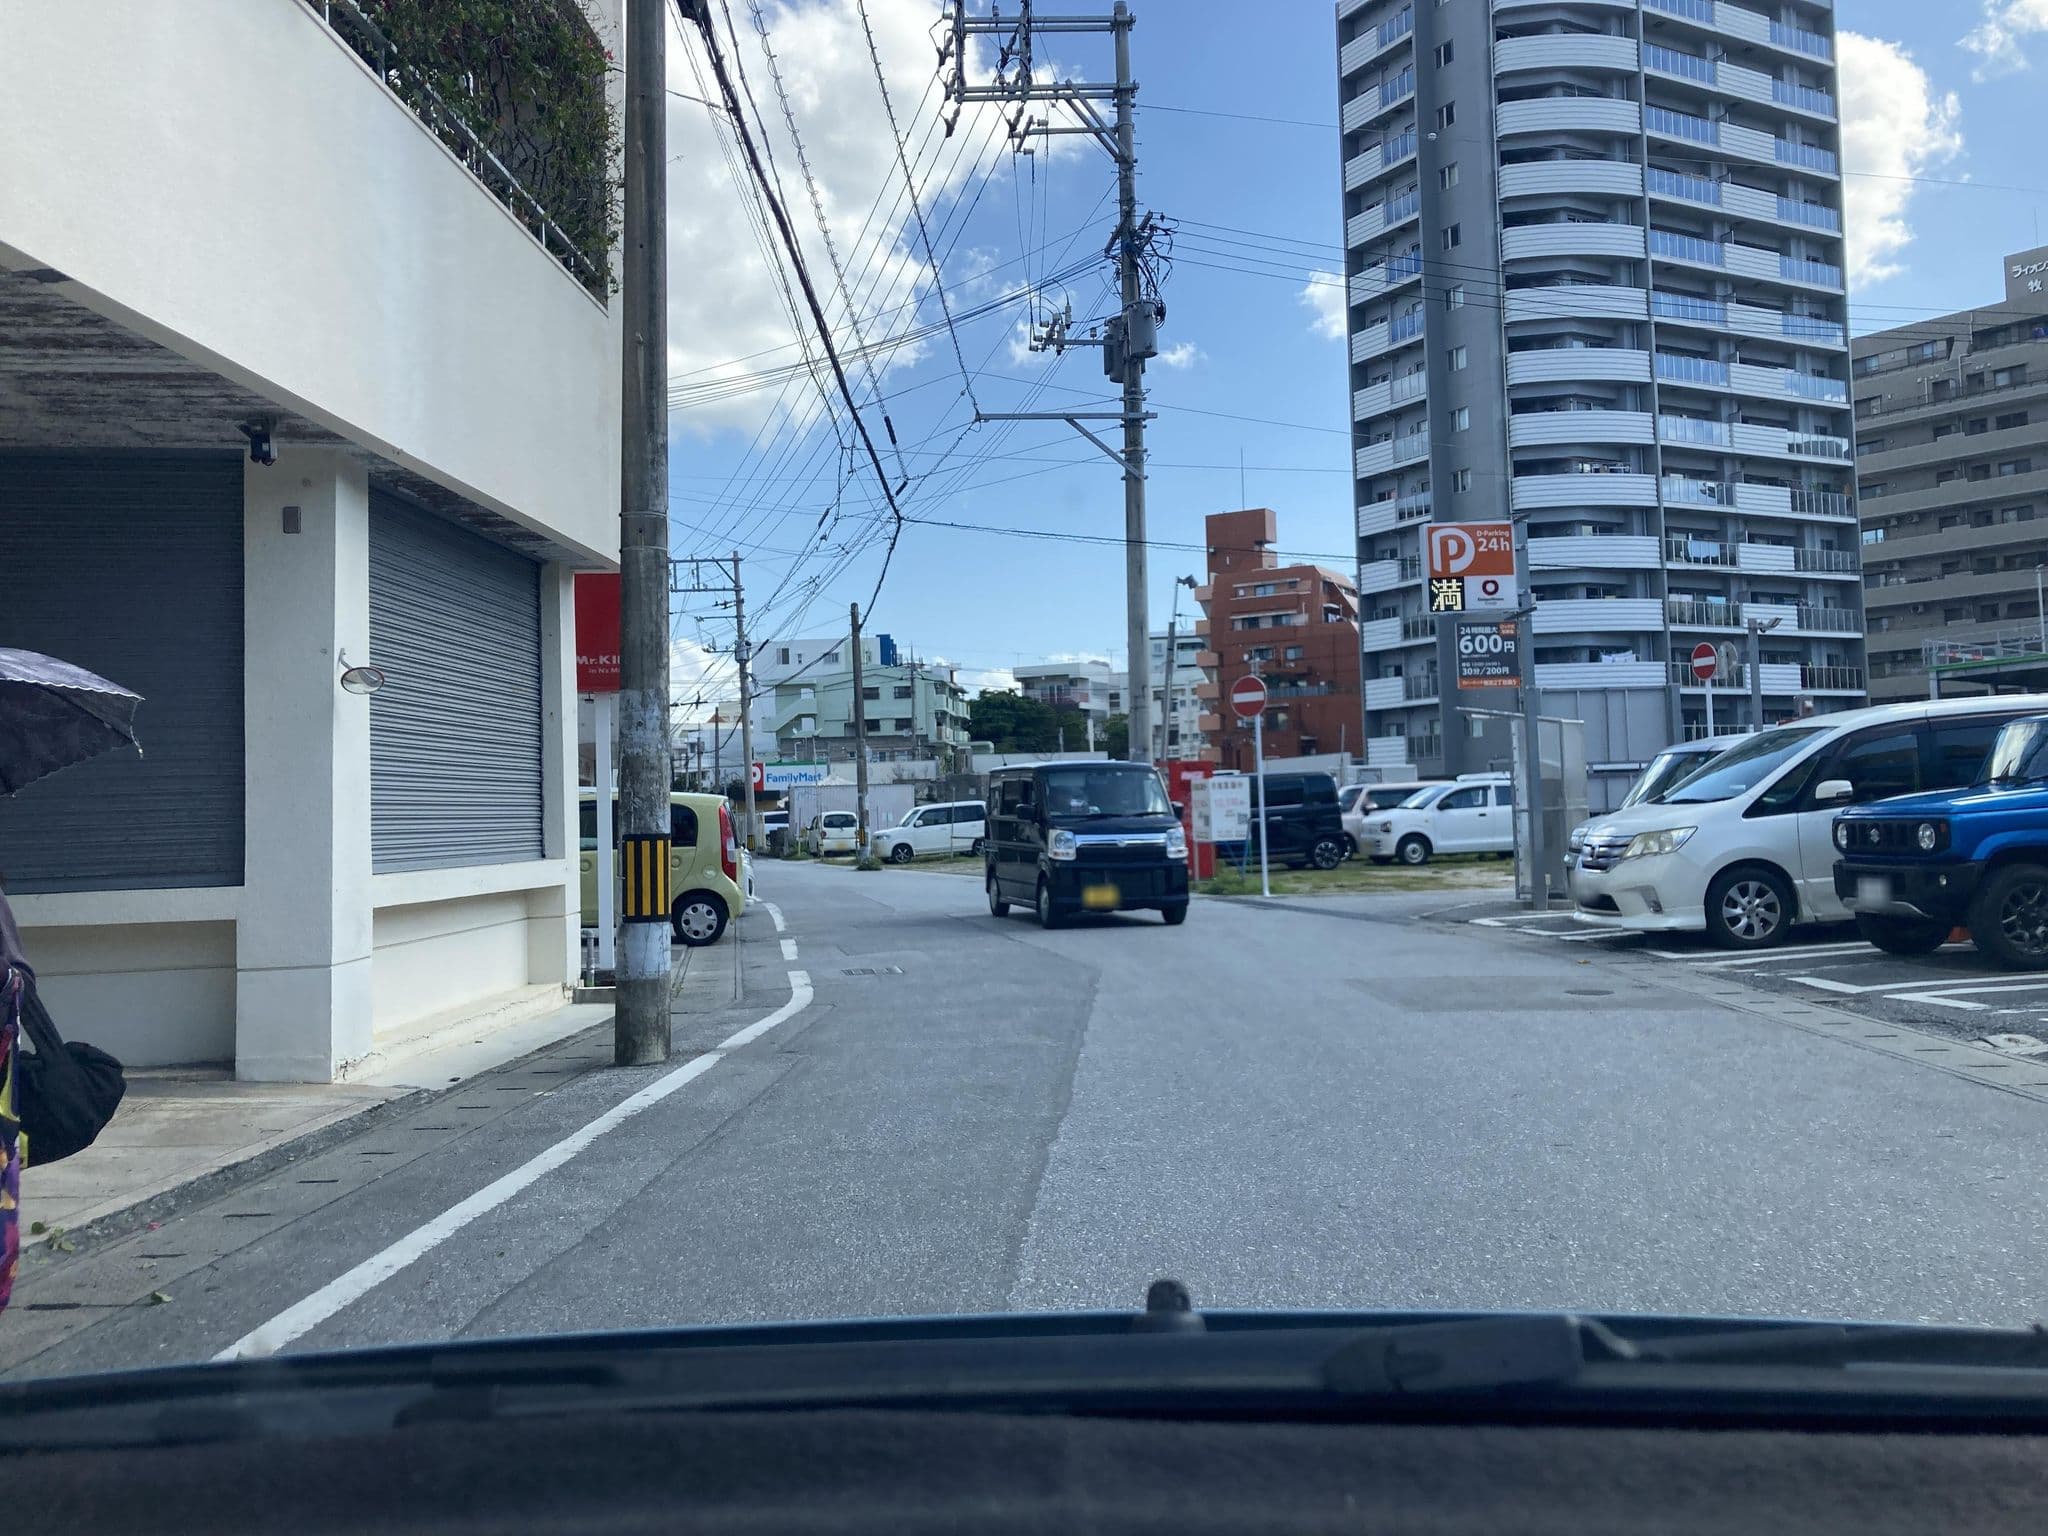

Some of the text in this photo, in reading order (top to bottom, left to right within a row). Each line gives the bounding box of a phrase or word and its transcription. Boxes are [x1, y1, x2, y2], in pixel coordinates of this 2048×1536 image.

[1478, 537, 1511, 552] 24h
[1431, 578, 1463, 612] 満
[1459, 634, 1515, 654] 600円
[766, 772, 822, 784] FamilyMart
